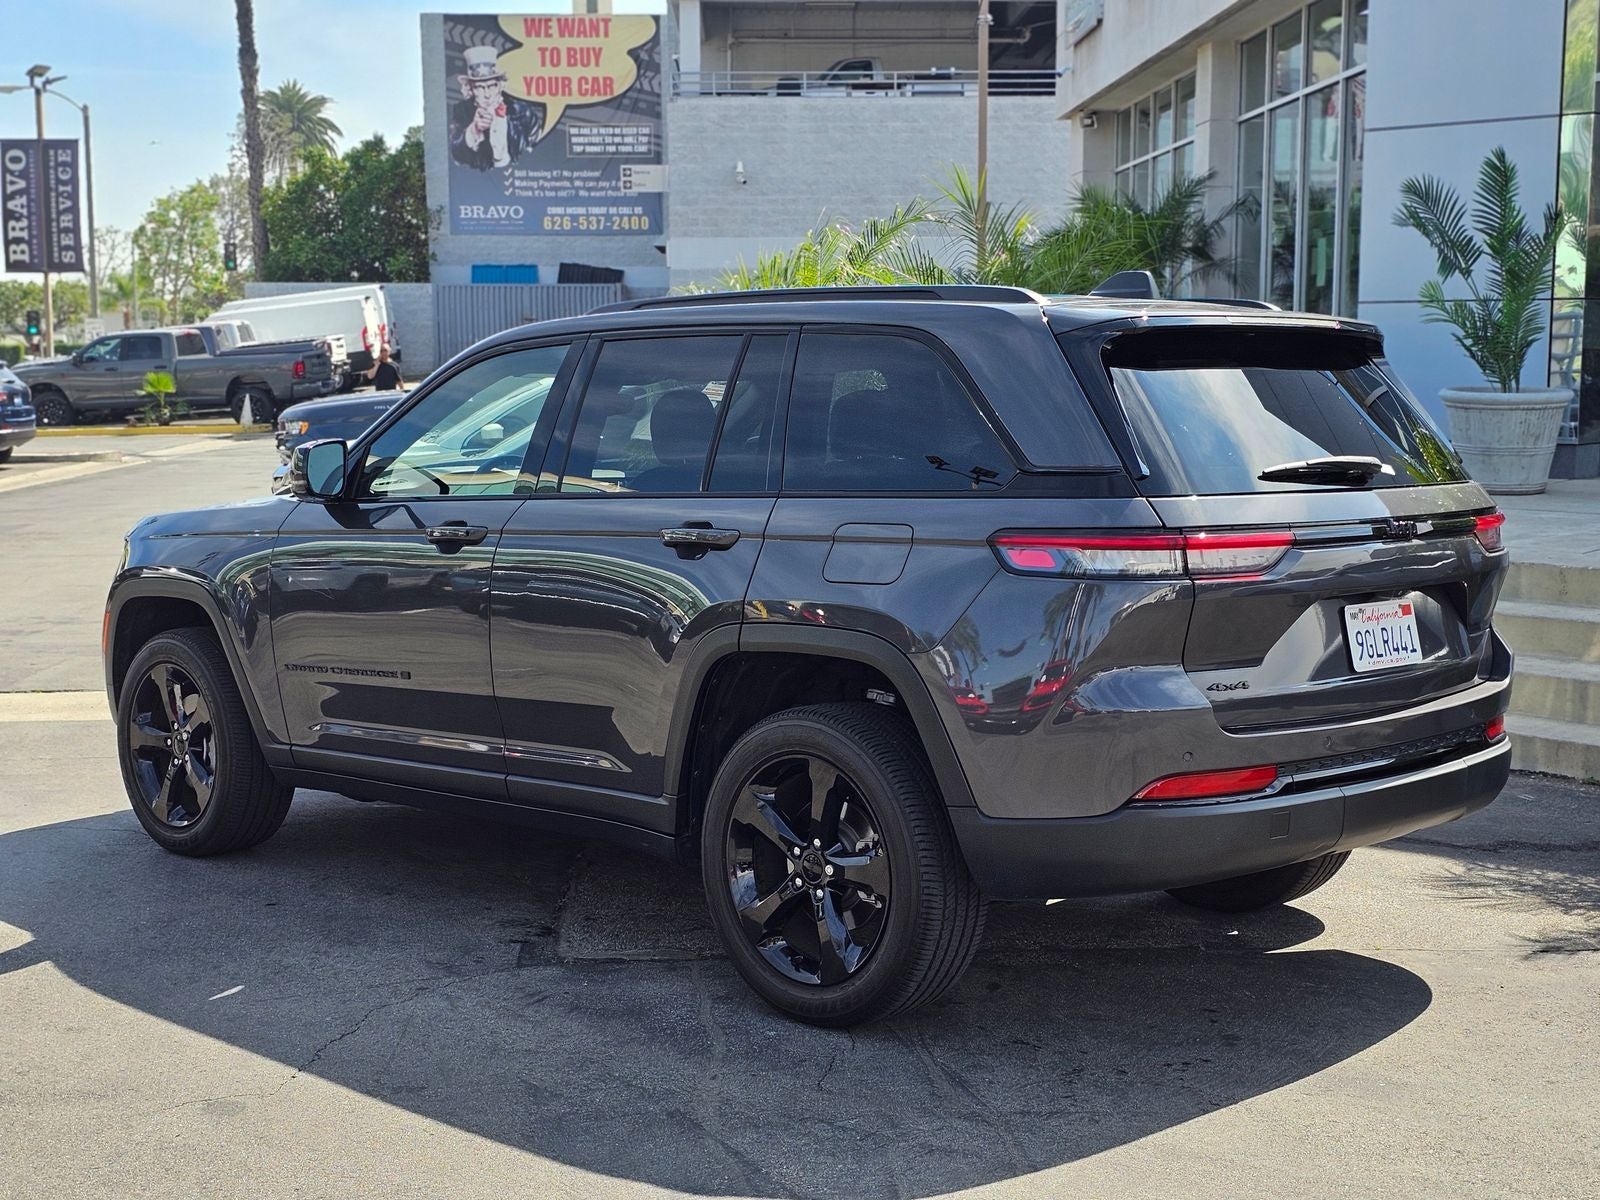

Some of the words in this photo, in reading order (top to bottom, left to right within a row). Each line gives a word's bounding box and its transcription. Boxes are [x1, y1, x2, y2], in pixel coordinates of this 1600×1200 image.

[523, 17, 553, 38] WE
[557, 17, 612, 38] WANT
[538, 46, 561, 68] TO
[566, 46, 603, 68] BUY
[523, 76, 572, 97] YOUR
[577, 76, 614, 97] CAR
[514, 179, 537, 188] Making
[514, 189, 532, 197] Think
[5, 148, 30, 263] BRAVO
[57, 149, 76, 263] SERVICE
[459, 205, 524, 219] BRAVO
[618, 206, 633, 215] CALL
[543, 216, 649, 230] 626-537-2400
[1361, 608, 1402, 626] California
[1355, 624, 1418, 661] 9GLR441
[1371, 656, 1407, 665] dmv.ca.gov
[1206, 680, 1250, 692] 4x4
